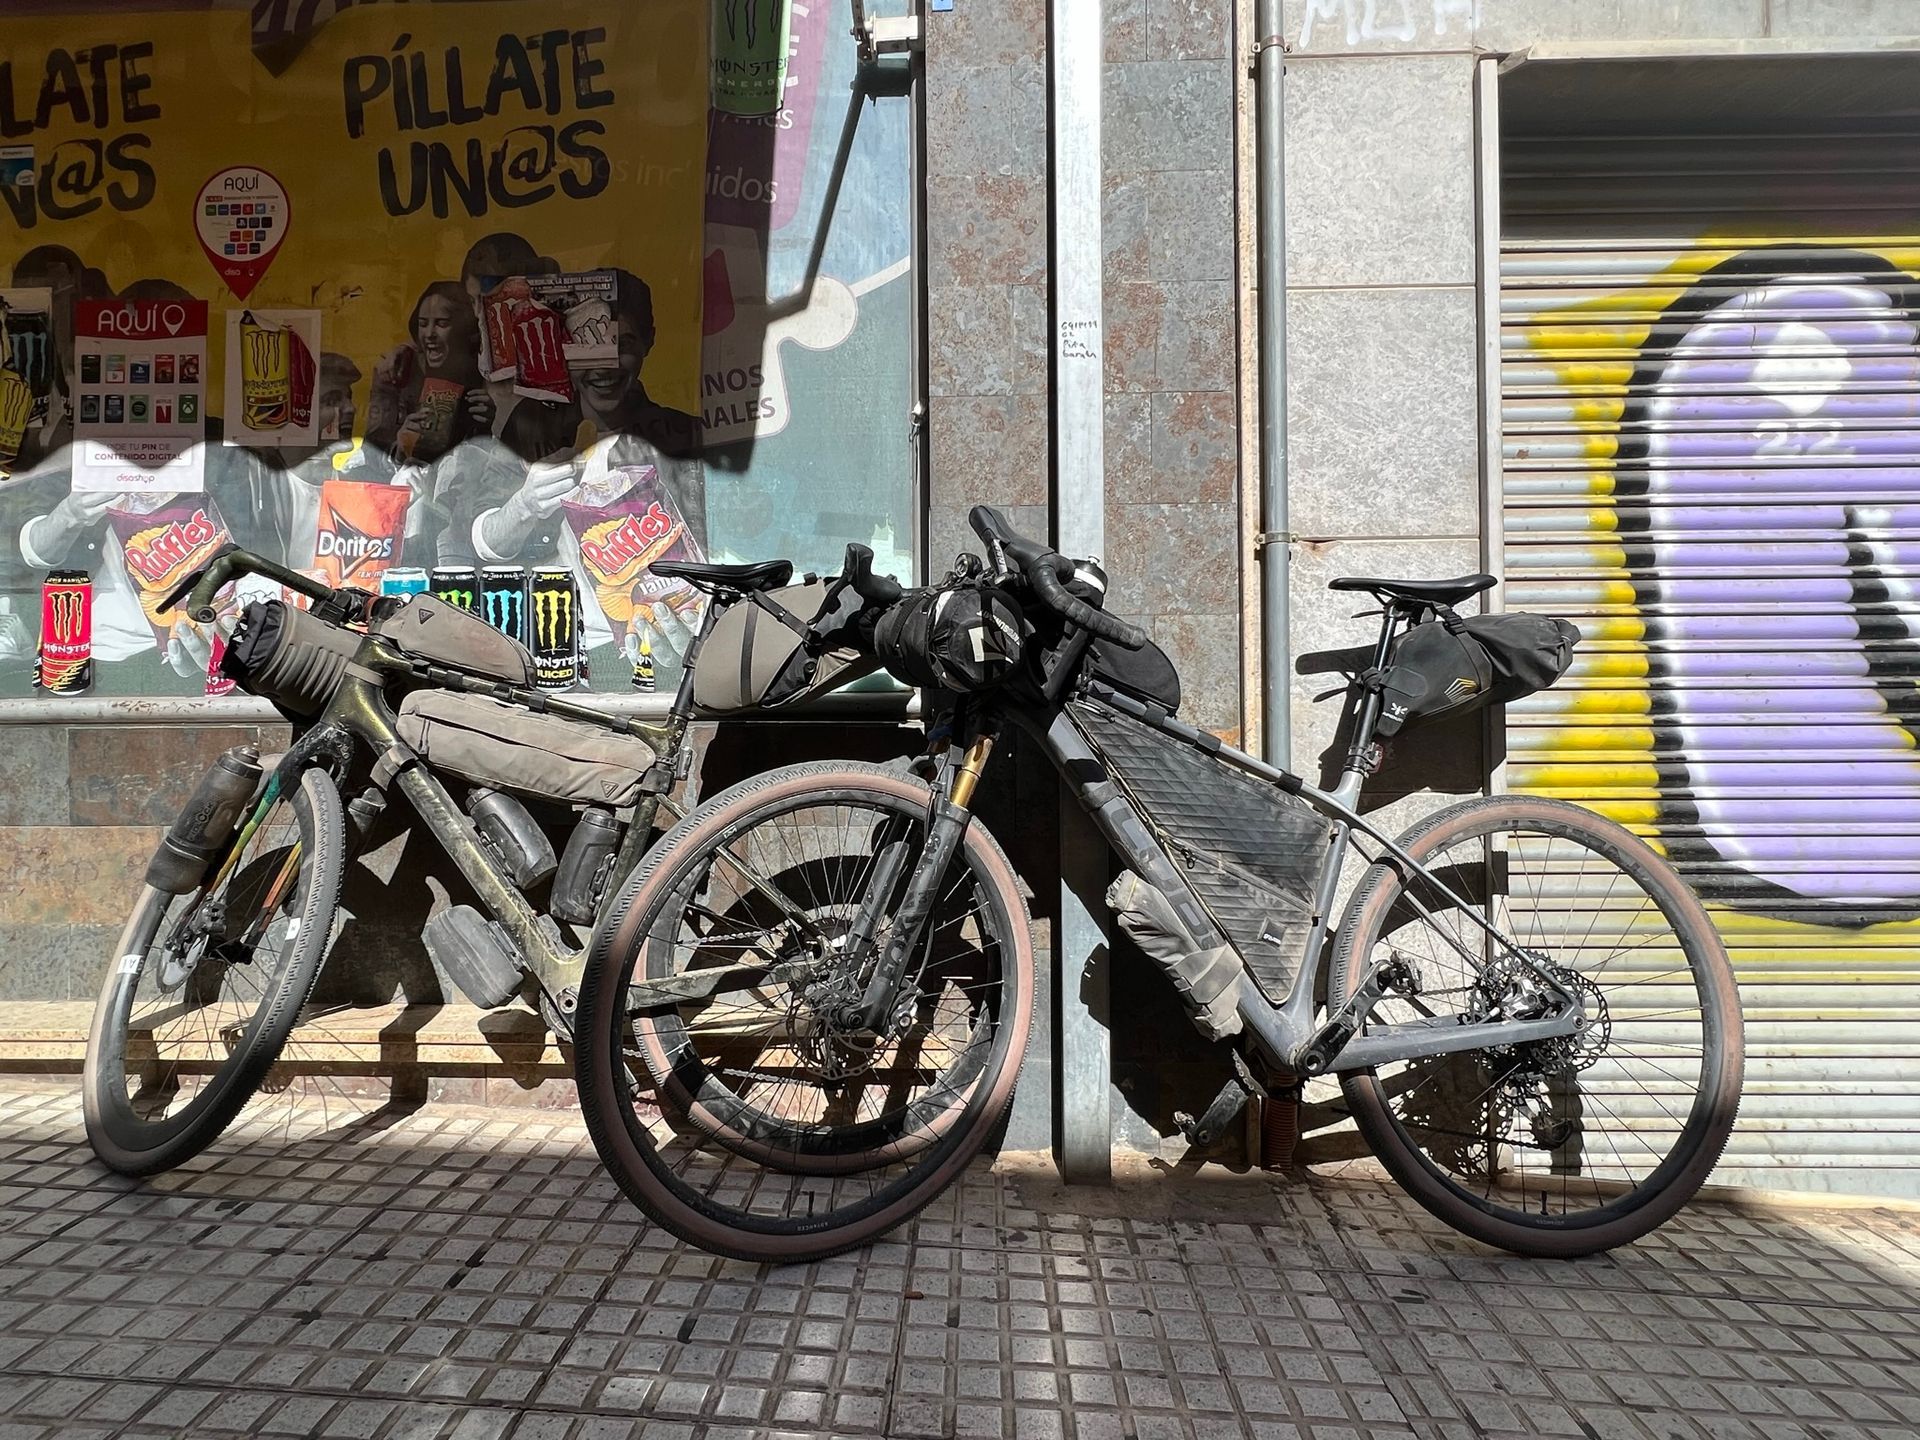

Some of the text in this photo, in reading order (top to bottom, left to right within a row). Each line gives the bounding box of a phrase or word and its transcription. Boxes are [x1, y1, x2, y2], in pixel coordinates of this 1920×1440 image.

[343, 27, 615, 139] PÍLLATE
[224, 174, 259, 192] AQUÍ
[378, 119, 611, 219] UN@S
[98, 303, 158, 336] AQUÍ
[94, 453, 182, 461] CONTENIDO DIGITAL
[125, 508, 217, 581] Ruffles
[318, 530, 393, 558] Doritos
[580, 500, 673, 577] Ruffles
[535, 655, 579, 669] ONSTER
